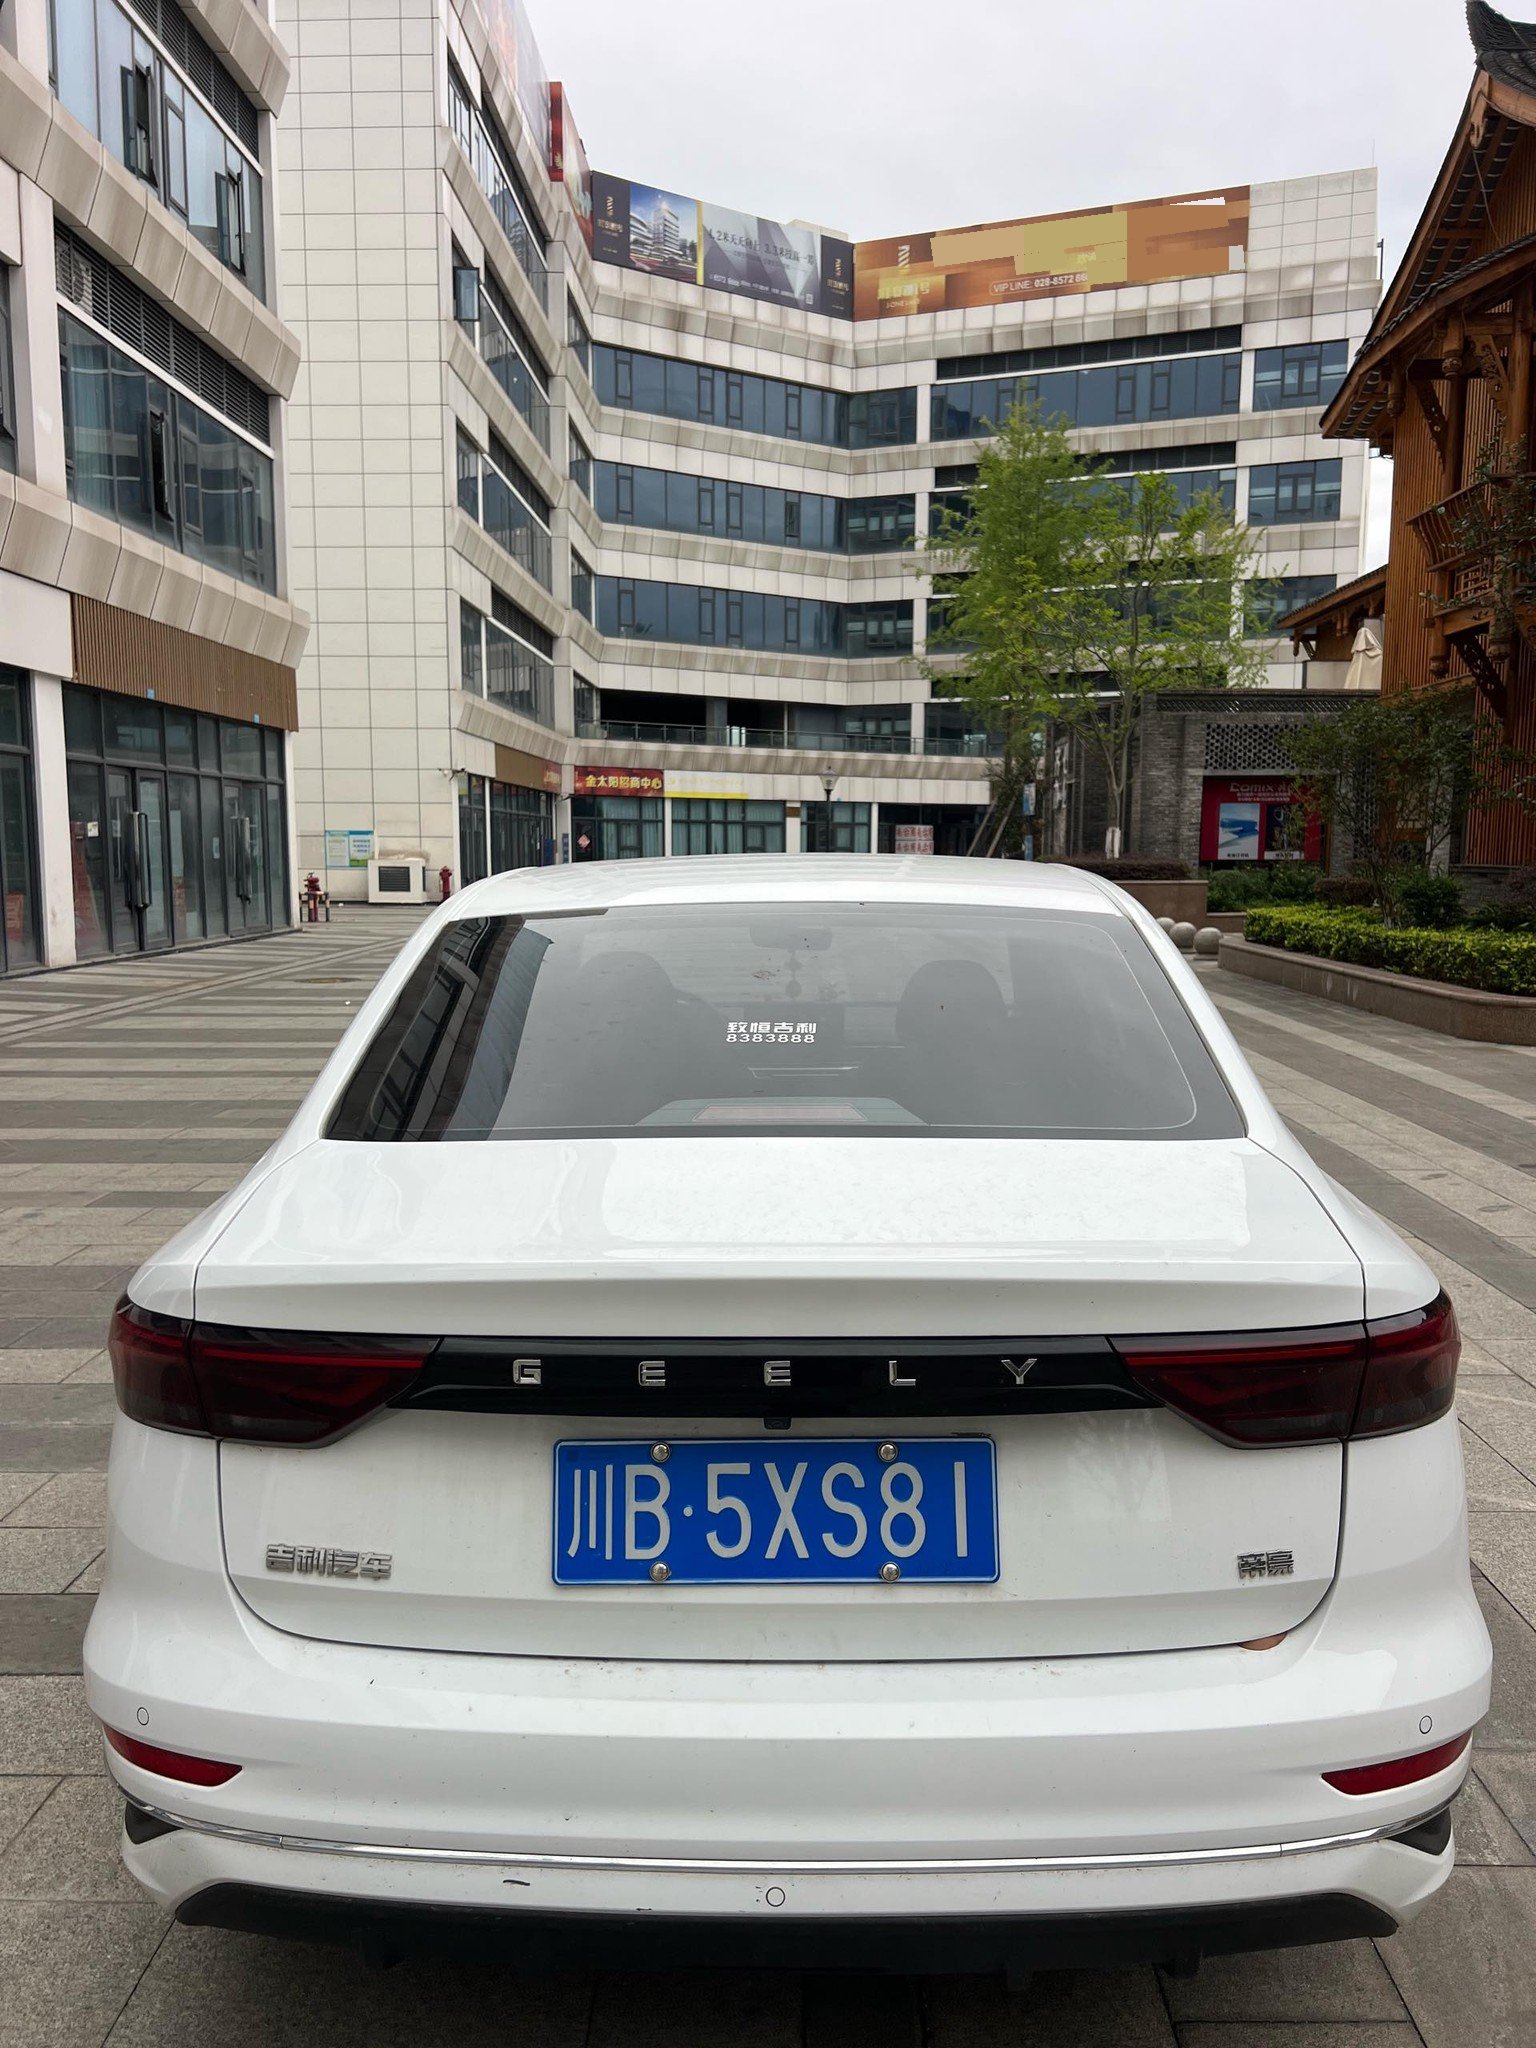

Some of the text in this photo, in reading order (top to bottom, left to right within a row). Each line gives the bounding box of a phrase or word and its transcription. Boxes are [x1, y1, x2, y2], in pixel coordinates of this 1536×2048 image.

[993, 283, 1009, 292] VIP
[585, 774, 662, 790] 金太阳招商中心
[727, 1021, 817, 1034] 致恒吉利
[726, 1034, 815, 1043] 8383888
[513, 1358, 1038, 1387] GEELY
[266, 1543, 393, 1581] 吉利汽车
